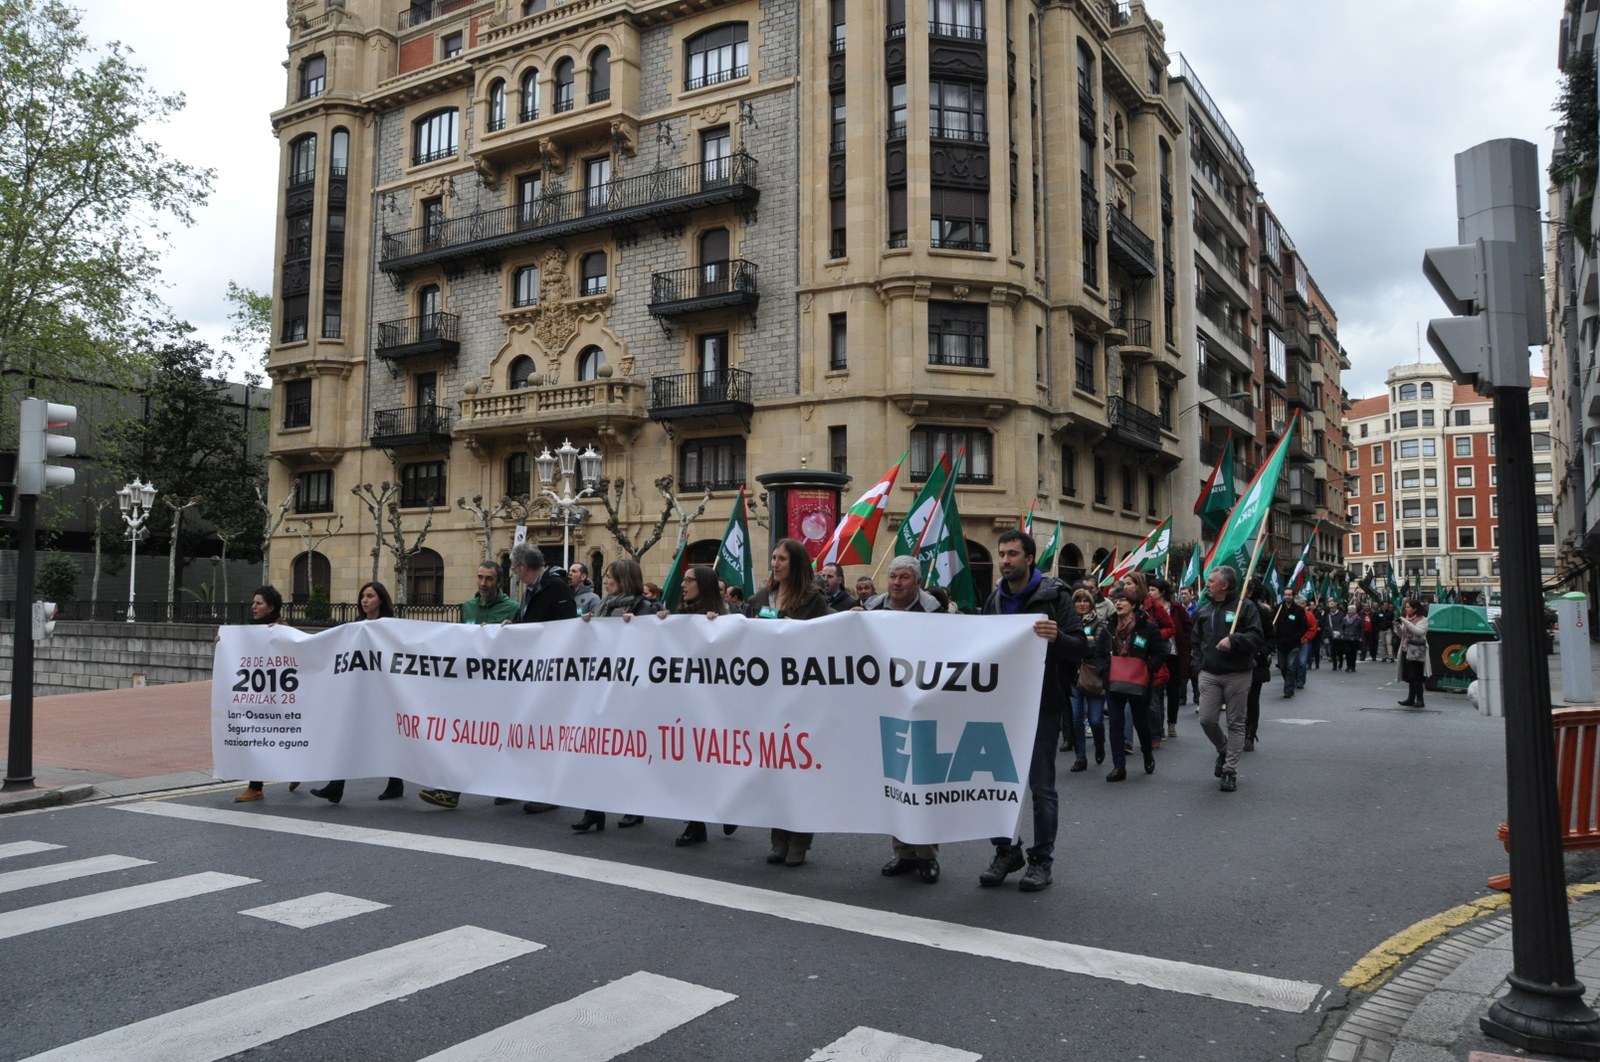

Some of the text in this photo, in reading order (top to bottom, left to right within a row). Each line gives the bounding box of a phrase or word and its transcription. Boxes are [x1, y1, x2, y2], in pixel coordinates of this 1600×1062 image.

[240, 655, 298, 667] 28 DE ABRIL
[334, 650, 999, 692] ESAN EZETZ PREKARIETATEARI, GEHIAGO BALIO DUZU
[232, 668, 299, 692] 2016
[232, 694, 295, 704] APIRILAK 28
[228, 710, 301, 720] Lan-Osasun eta
[228, 724, 302, 735] Segurtasunaren
[224, 739, 309, 749] nazioarteko eguna
[396, 713, 822, 770] POR TU SALUD, NO A LA PRECARIEDAD, TÚ VALES MÁS.
[879, 715, 1020, 785] ELA
[884, 785, 1019, 806] EUSKAL SINDIKATUA
